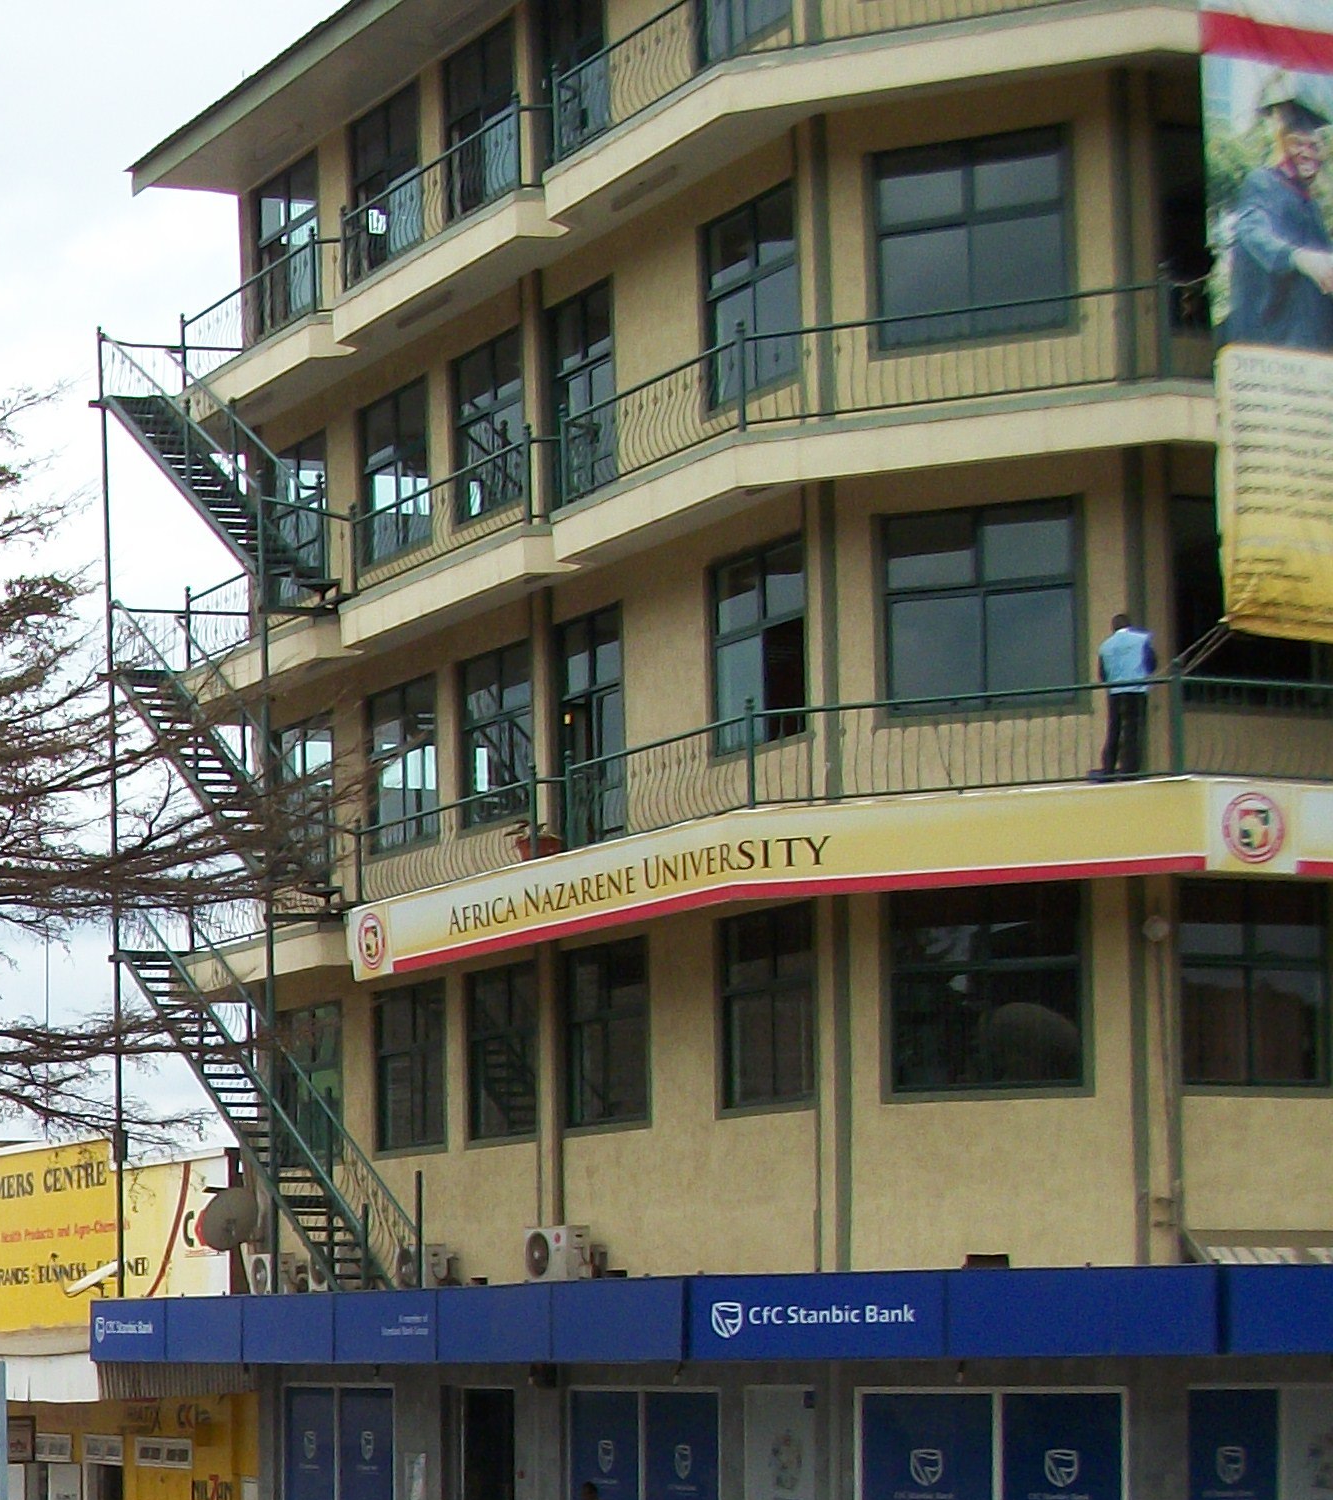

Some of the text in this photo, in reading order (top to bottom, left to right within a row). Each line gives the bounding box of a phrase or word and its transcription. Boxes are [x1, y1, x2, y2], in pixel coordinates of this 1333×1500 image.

[448, 835, 831, 936] AFRICA NAZARENE UNIVERSITY
[43, 1161, 107, 1193] CENTRE
[24, 1228, 53, 1242] Products
[57, 1226, 70, 1238] and
[748, 1304, 915, 1325] CfC Stanbic Bank
